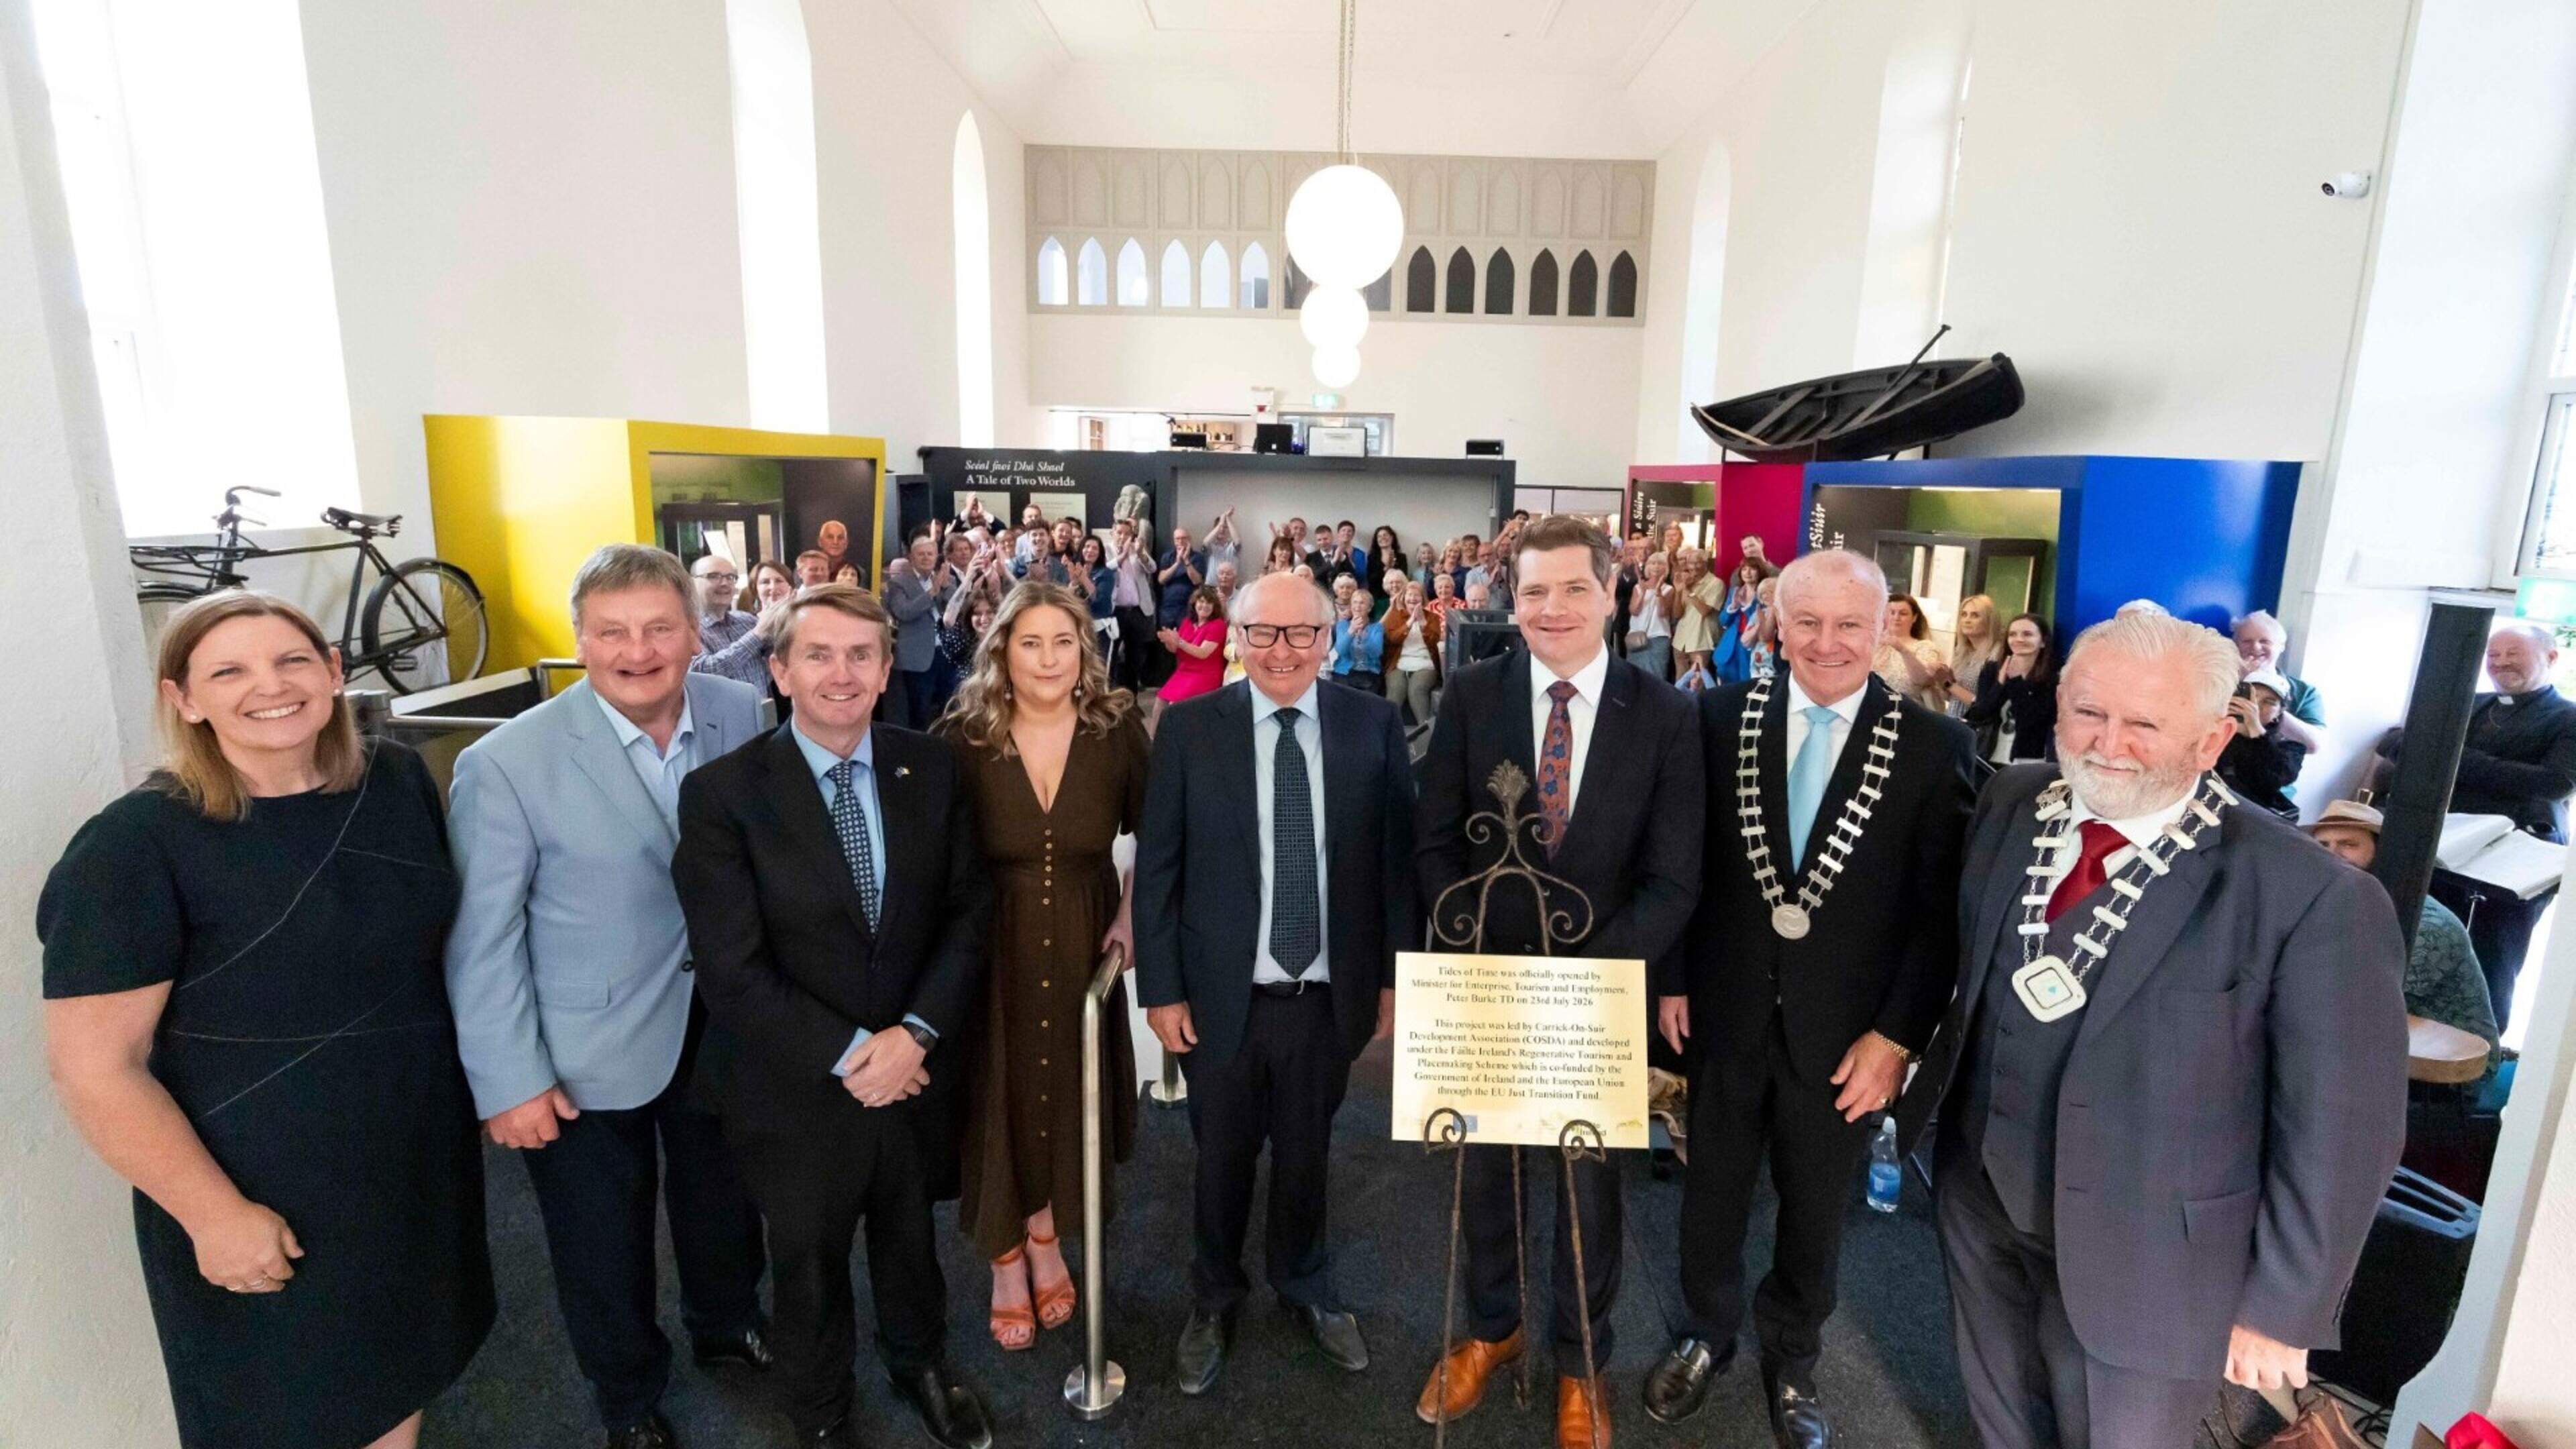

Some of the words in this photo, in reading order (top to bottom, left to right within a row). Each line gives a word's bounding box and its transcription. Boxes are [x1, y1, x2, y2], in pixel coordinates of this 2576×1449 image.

[965, 460, 989, 470] Scéal
[989, 460, 1011, 473] faoi
[1014, 461, 1034, 472] Dhá
[1037, 462, 1065, 472] Shaol
[966, 474, 975, 484] A
[976, 474, 998, 484] Tale
[1000, 474, 1012, 485] of
[1014, 476, 1036, 486] Two
[1038, 476, 1075, 486] Worlds
[1646, 498, 1656, 521] Suir
[1438, 966, 1461, 975] Tides
[1463, 967, 1472, 976] of
[1476, 968, 1498, 977] Time
[1519, 969, 1555, 981] officially
[1557, 971, 1589, 981] opened
[1591, 972, 1601, 982] by
[1411, 979, 1447, 988] Minister
[1450, 980, 1462, 988] for
[1465, 981, 1511, 991] Enterprise,
[1515, 982, 1550, 991] Tourism
[1572, 985, 1628, 996] Employment,
[1446, 993, 1468, 1002] Peter
[1471, 994, 1497, 1003] Burke
[1500, 995, 1514, 1004] TD
[1530, 996, 1550, 1004] 23rd
[1552, 997, 1570, 1008] July
[1572, 997, 1593, 1006] 2026
[1435, 1019, 1453, 1027] This
[1455, 1020, 1486, 1030] project
[1507, 1022, 1520, 1030] led
[1522, 1022, 1532, 1032] by
[1535, 1022, 1606, 1032] Carrick-On-Suir
[1409, 1031, 1466, 1042] Development
[1470, 1034, 1521, 1043] Association
[1522, 1035, 1565, 1045] (COSDA)
[1568, 1038, 1585, 1046] and
[1587, 1038, 1629, 1049] developed
[1407, 1045, 1433, 1054] under
[1434, 1046, 1448, 1054] the
[1451, 1046, 1476, 1055] Fáilte
[1479, 1047, 1516, 1057] Ireland's
[1519, 1049, 1575, 1059] Regenerative
[1578, 1051, 1613, 1060] Tourism
[1616, 1052, 1632, 1061] and
[1417, 1058, 1473, 1071] Placemaking
[1475, 1061, 1509, 1069] Scheme
[1511, 1062, 1537, 1071] which
[1540, 1063, 1547, 1071] is
[1549, 1063, 1593, 1073] co-funded
[1595, 1064, 1605, 1074] by
[1608, 1065, 1621, 1073] the
[1414, 1071, 1468, 1082] Government
[1471, 1073, 1481, 1082] of
[1483, 1075, 1515, 1083] Ireland
[1517, 1076, 1533, 1085] and
[1536, 1077, 1549, 1085] the
[1552, 1077, 1595, 1087] European
[1597, 1078, 1625, 1087] Union
[1438, 1086, 1472, 1097] through
[1474, 1087, 1488, 1096] the
[1491, 1088, 1505, 1096] EU
[1508, 1089, 1525, 1097] Just
[1528, 1089, 1573, 1099] Transition
